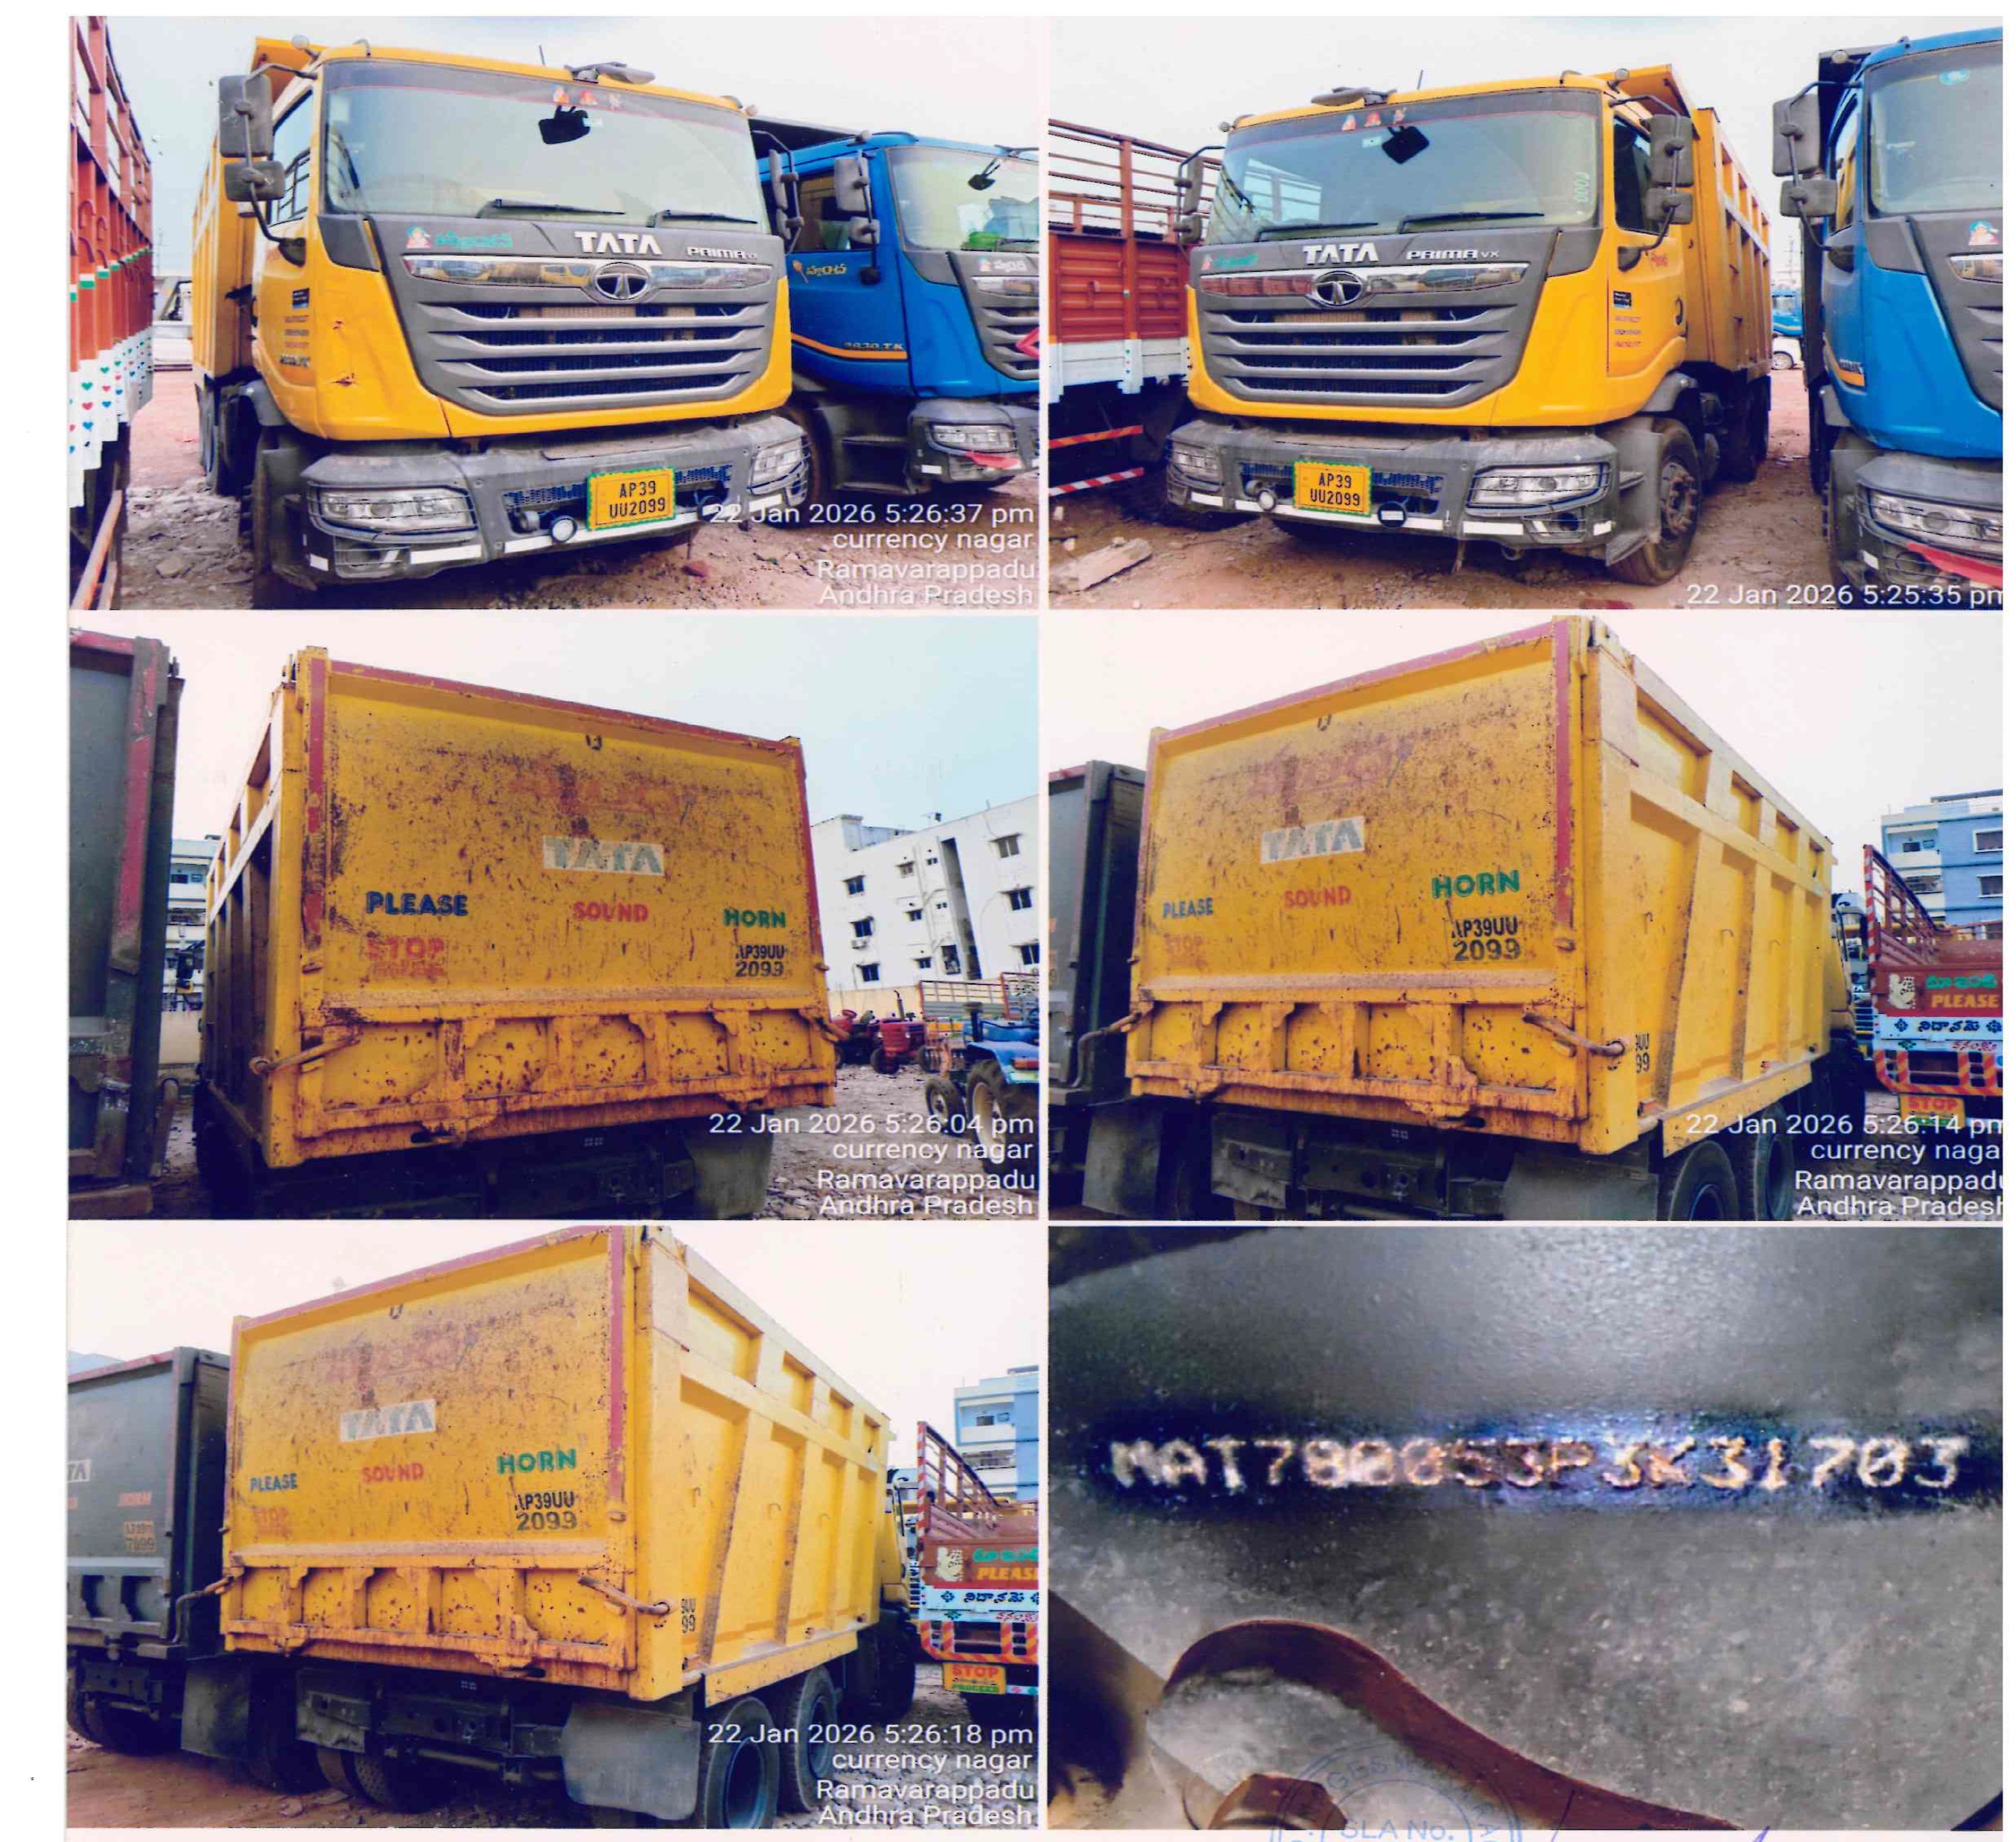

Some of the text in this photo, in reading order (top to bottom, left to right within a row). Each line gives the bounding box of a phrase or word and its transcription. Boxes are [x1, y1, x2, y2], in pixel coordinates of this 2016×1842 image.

[574, 230, 662, 255] TATA
[687, 247, 745, 260] PRIMA
[1303, 242, 1379, 265] TATA
[1406, 249, 1478, 260] PRIMA
[619, 480, 656, 498] AP39
[1318, 472, 1352, 489] AP39
[1310, 489, 1360, 506] UU2099
[609, 498, 666, 518] UU2099
[1262, 819, 1363, 860] TATA
[545, 837, 662, 874] TATA
[1163, 870, 1520, 918] PLEASE SOUND HORN
[366, 892, 786, 929] PLEASE SOUND HORN
[368, 937, 445, 960] STOP
[1453, 938, 1521, 961] 2099
[1931, 994, 1999, 1009] PLEASE
[1909, 1097, 1958, 1110] STOP
[343, 1402, 433, 1440] TATA
[250, 1449, 576, 1492] PLEASE SOUND HORN
[515, 1511, 577, 1531] 2099
[952, 1664, 999, 1677] STOP
[1408, 1820, 1454, 1839] No.
